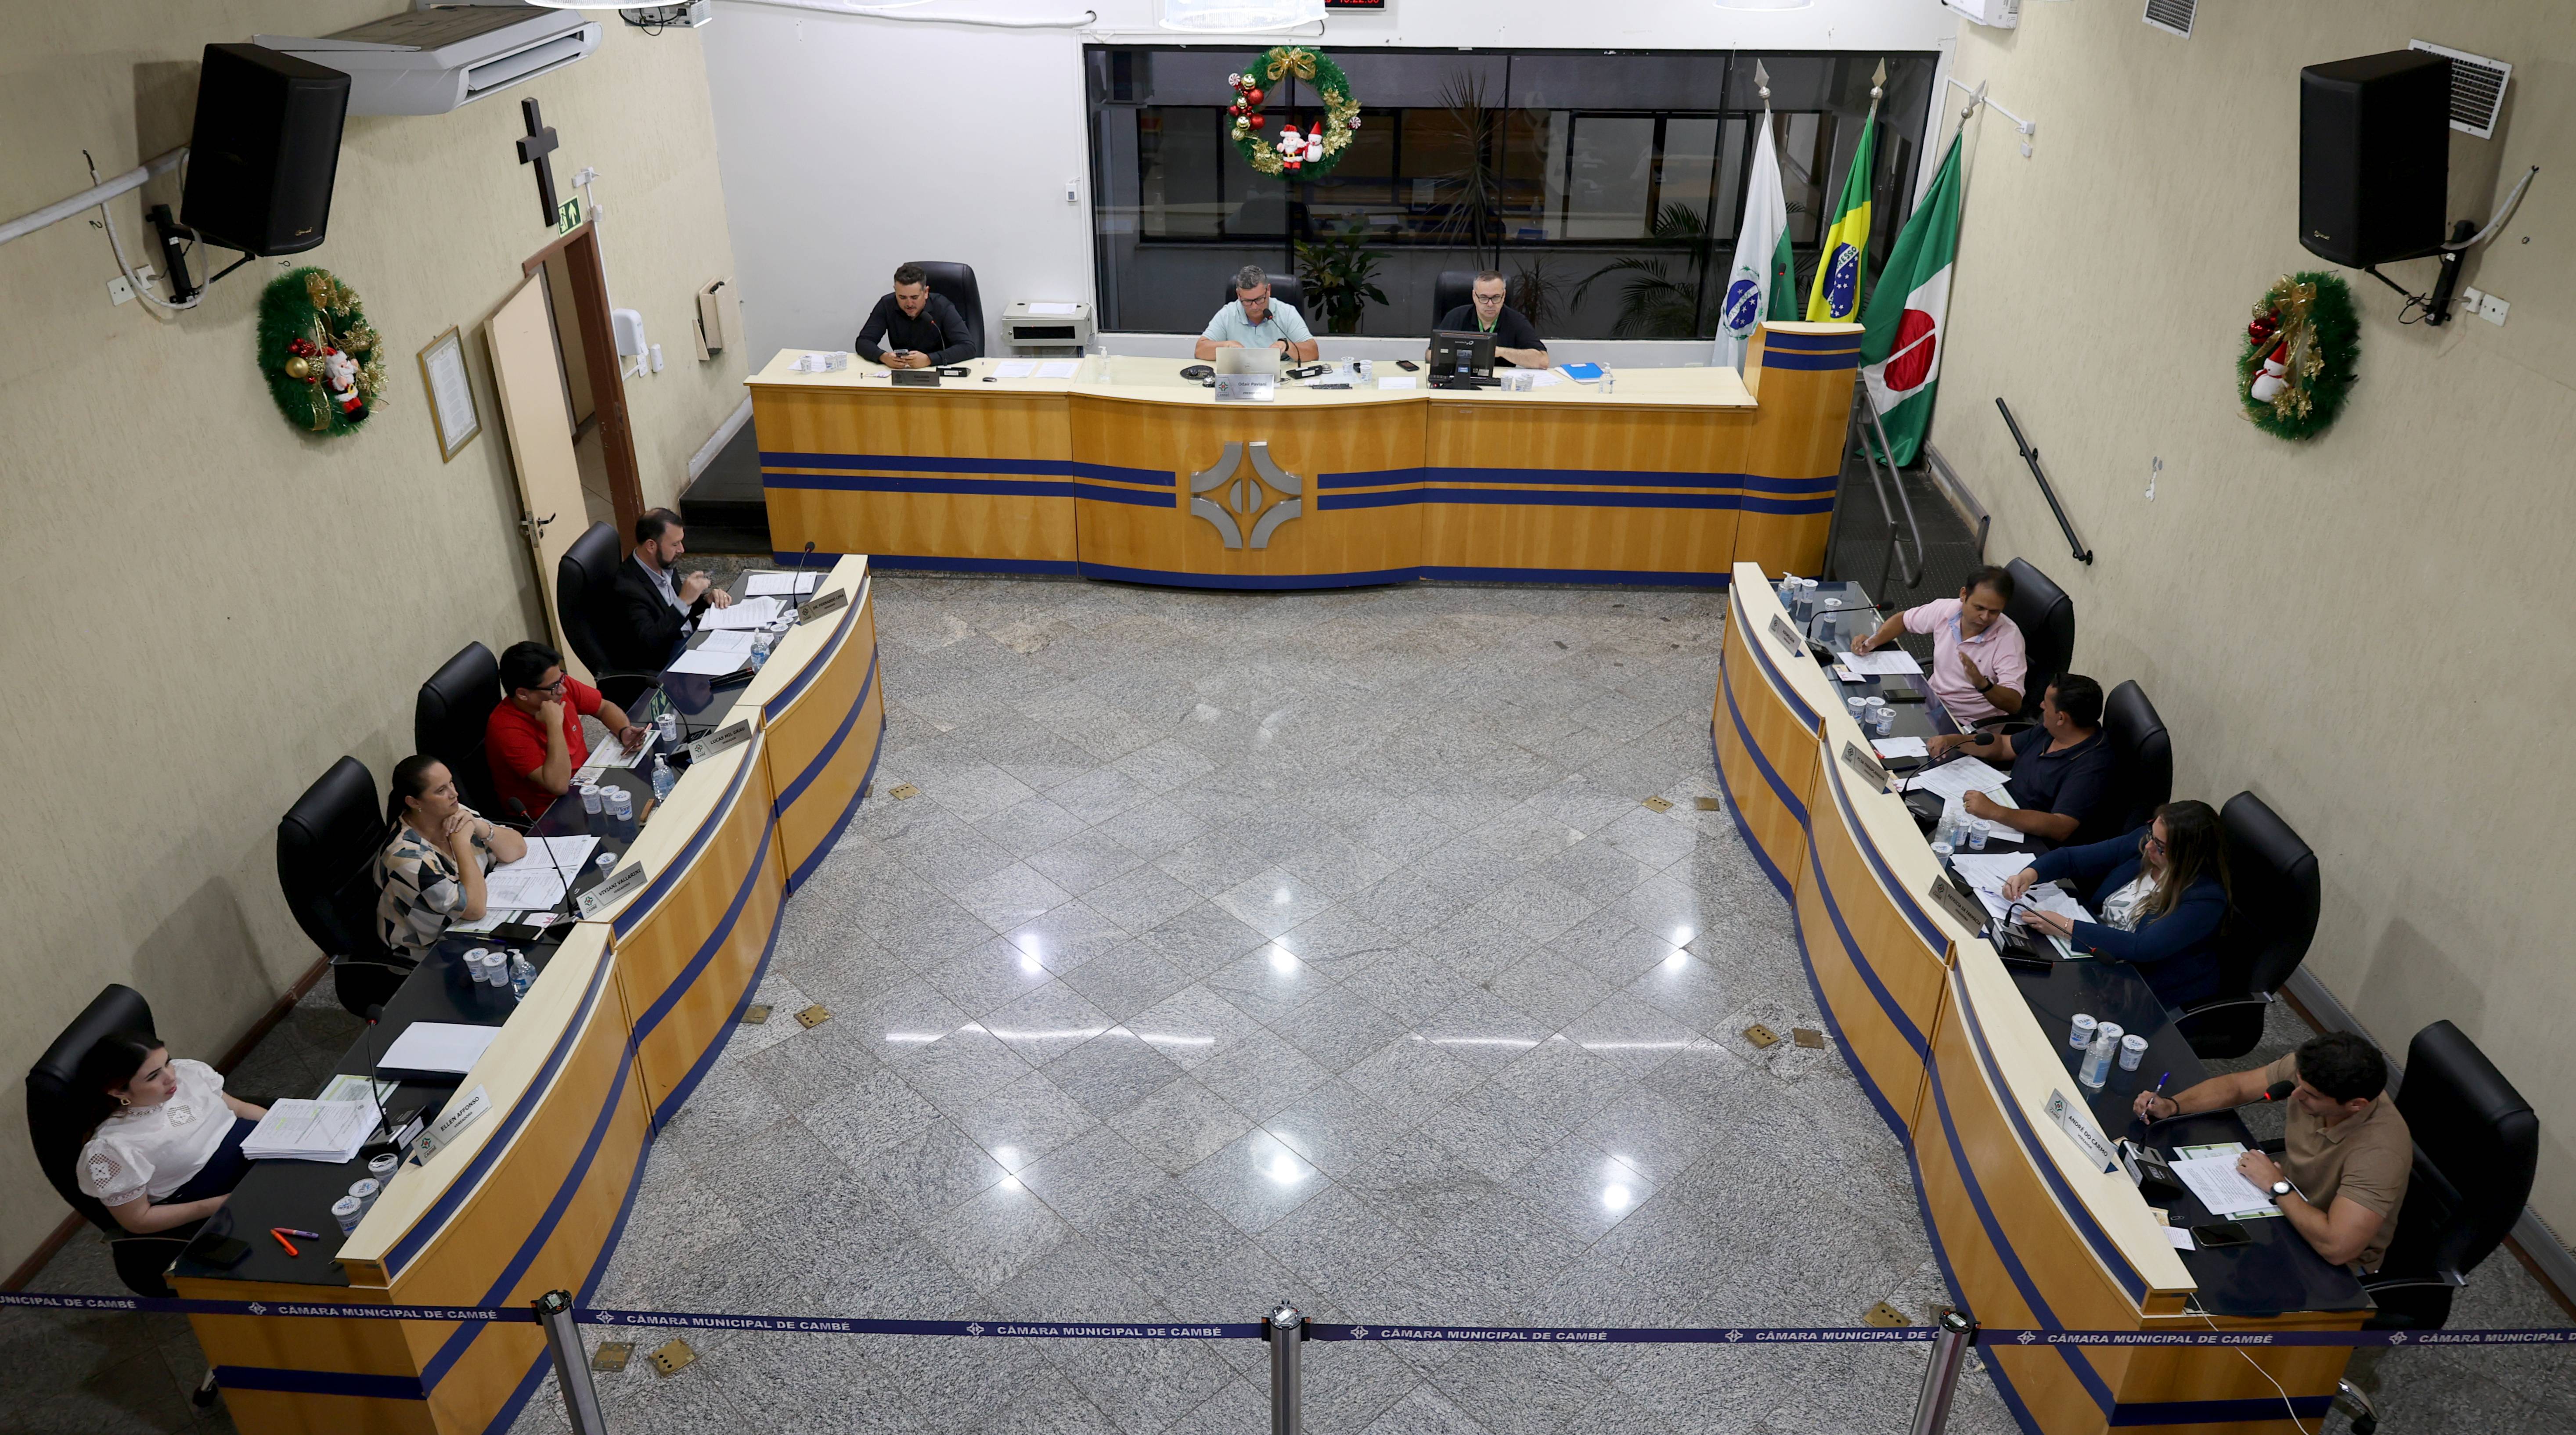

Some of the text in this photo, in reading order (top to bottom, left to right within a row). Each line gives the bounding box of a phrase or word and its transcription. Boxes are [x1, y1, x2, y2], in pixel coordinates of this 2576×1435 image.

[710, 736, 724, 744] LUCAS
[598, 869, 641, 896] VIVIANI VALLARINI
[440, 1097, 479, 1131] ELLEN AFFONSO
[454, 1111, 473, 1128] VEREADORA
[2068, 1116, 2108, 1156] ANDRÉ DO CARMO
[2078, 1134, 2092, 1150] VEREADOR
[86, 1299, 137, 1309] CAMBÉ
[278, 1306, 339, 1315] CÂMARA
[342, 1308, 421, 1318] MUNICIPAL
[447, 1310, 497, 1319] CAMBÉ
[627, 1314, 688, 1325] CÂMARA
[692, 1318, 772, 1328] MUNICIPAL
[800, 1321, 850, 1331] CAMBÉ
[997, 1325, 1059, 1335] CÂMARA
[1063, 1327, 1143, 1336] MUNICIPAL
[1171, 1327, 1221, 1336] CAMBÉ
[1381, 1328, 1442, 1338] CÂMARA
[1447, 1331, 1528, 1339] MUNICIPAL
[1556, 1331, 1607, 1340] CAMBÉ
[1756, 1331, 1817, 1340] CÂMARA
[2047, 1333, 2109, 1343] CÂMARA
[2221, 1334, 2273, 1343] CAMBÉ
[2419, 1333, 2480, 1342] CÂMARA
[2484, 1333, 2563, 1342] MUNICIPAL
